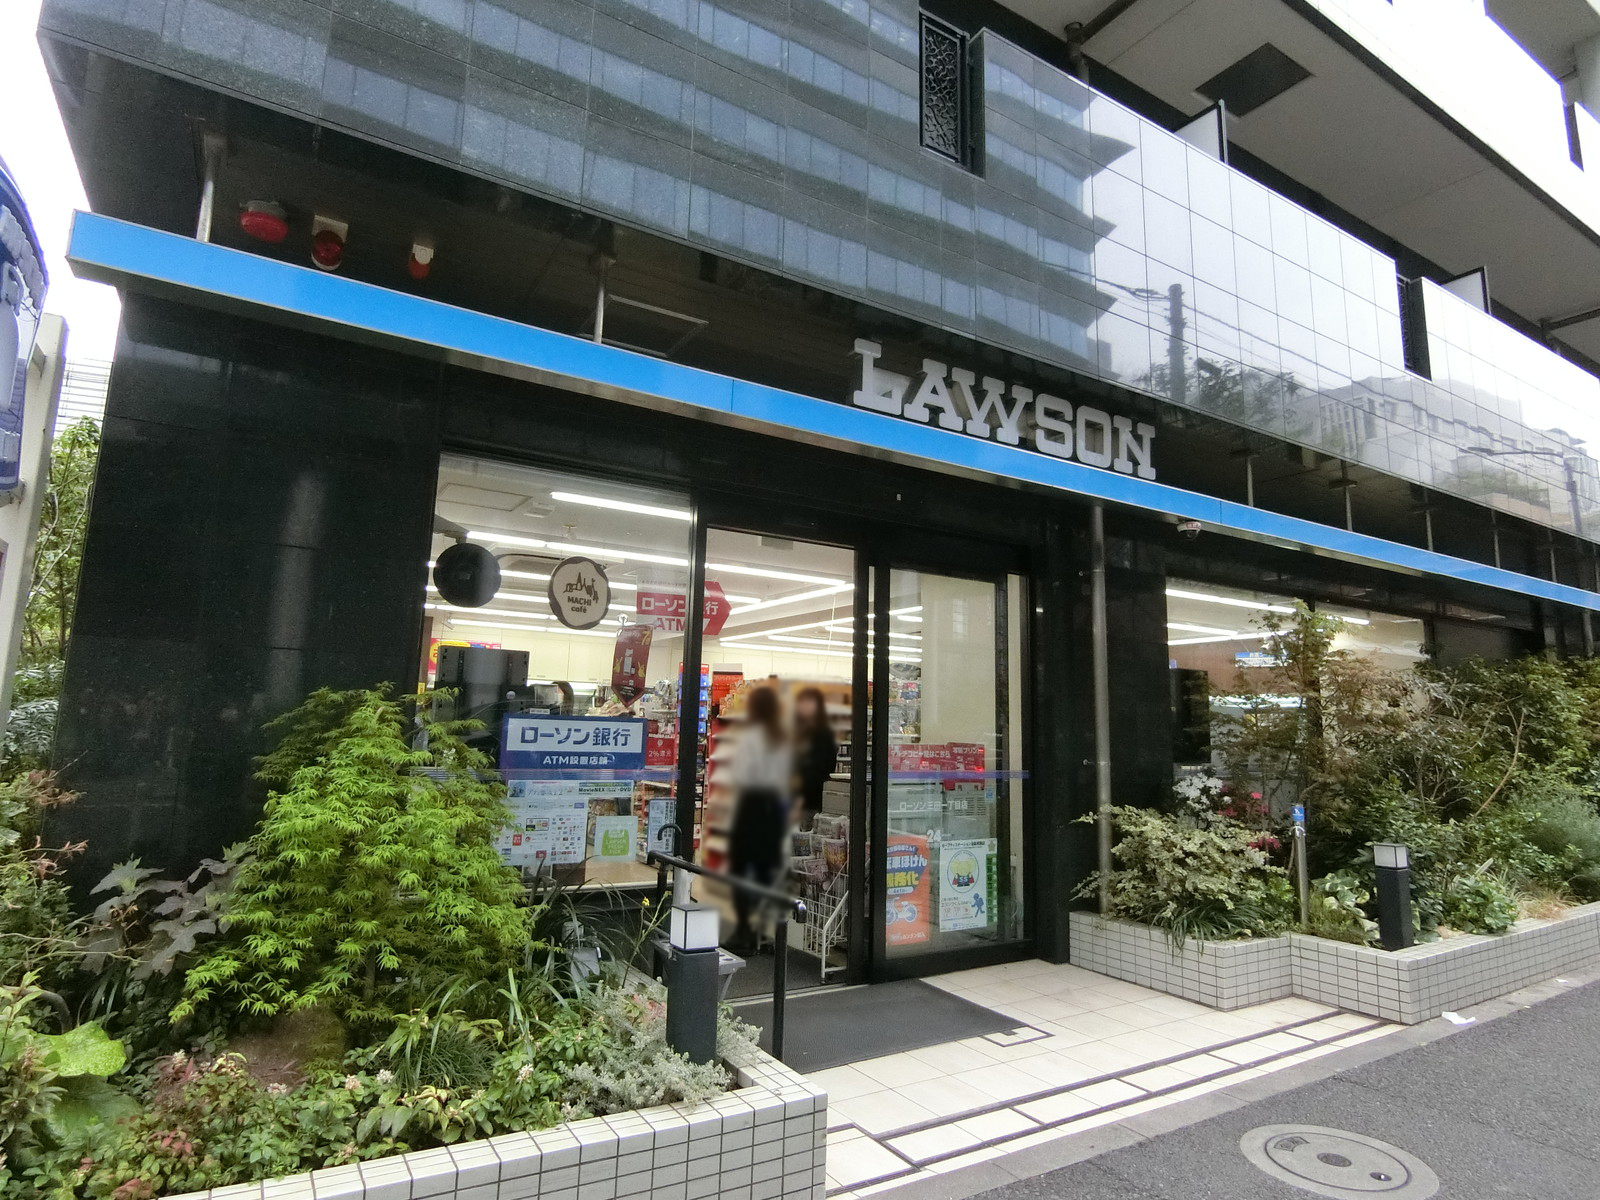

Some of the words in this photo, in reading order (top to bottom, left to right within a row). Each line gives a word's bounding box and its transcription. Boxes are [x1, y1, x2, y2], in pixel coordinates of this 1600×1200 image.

[853, 338, 1156, 480] LAWSON
[567, 596, 592, 606] MACHI
[520, 726, 631, 746] ローソン銀行
[543, 755, 609, 765] ATM設置店舗
